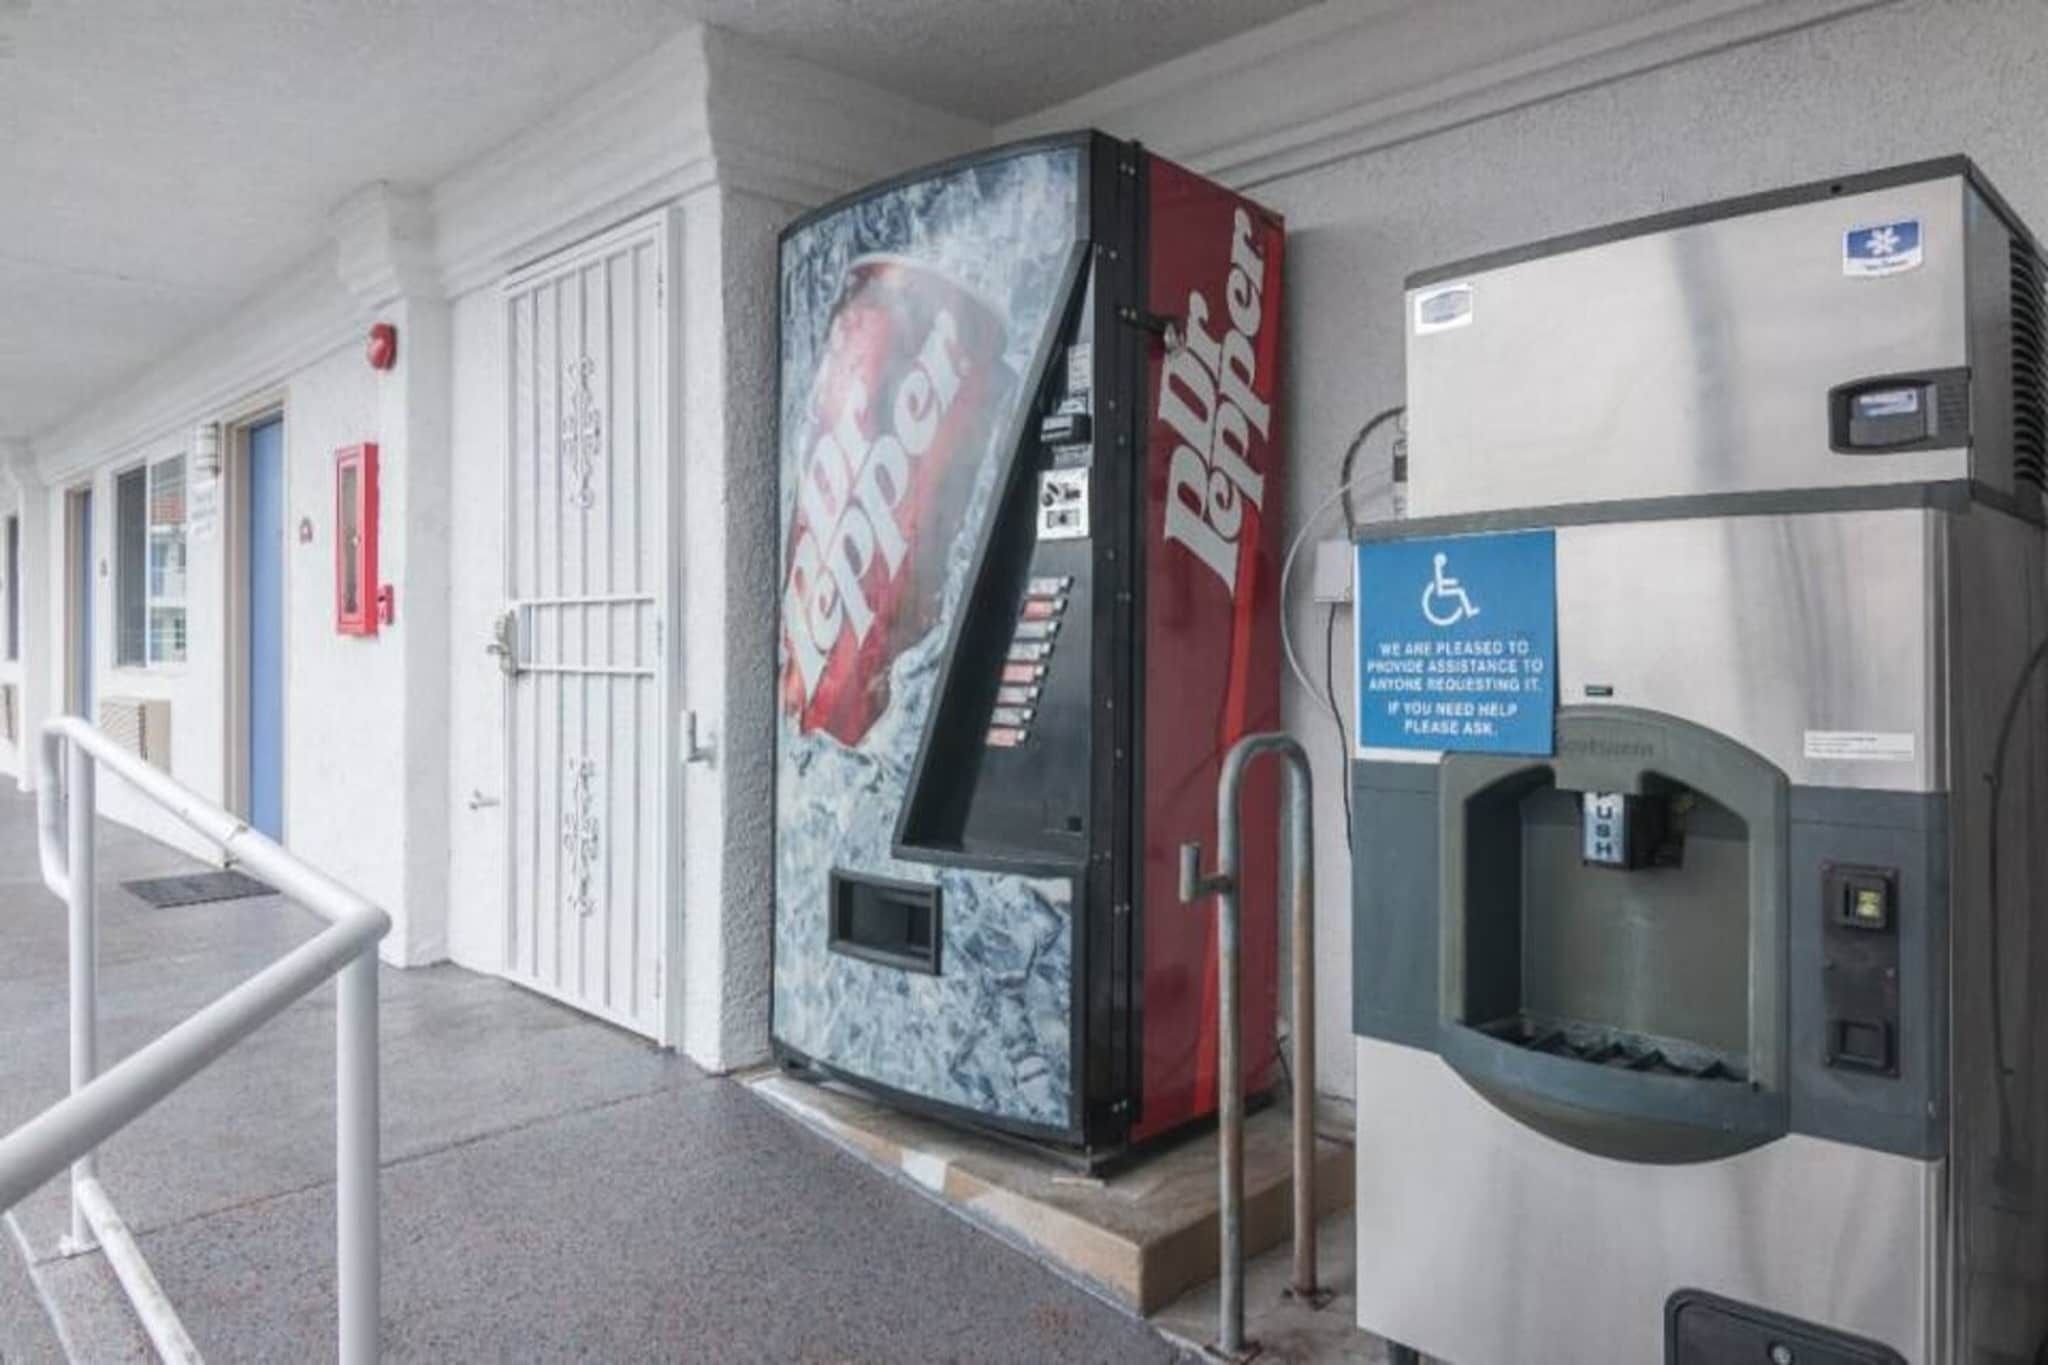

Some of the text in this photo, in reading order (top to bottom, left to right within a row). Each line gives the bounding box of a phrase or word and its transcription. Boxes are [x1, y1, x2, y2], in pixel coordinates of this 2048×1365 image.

[1157, 207, 1271, 598] Dr Pepper
[781, 308, 961, 702] Dr Pepper
[1379, 639, 1530, 657] WE ARE PLEASED TO
[1367, 658, 1544, 674] PROVIDE ASSISTANCE TO
[1368, 677, 1423, 691] ANYONE
[1426, 677, 1520, 692] REQUESTING
[1387, 701, 1519, 717] IF YOU NEED HELP
[1404, 719, 1459, 735] PLEASE
